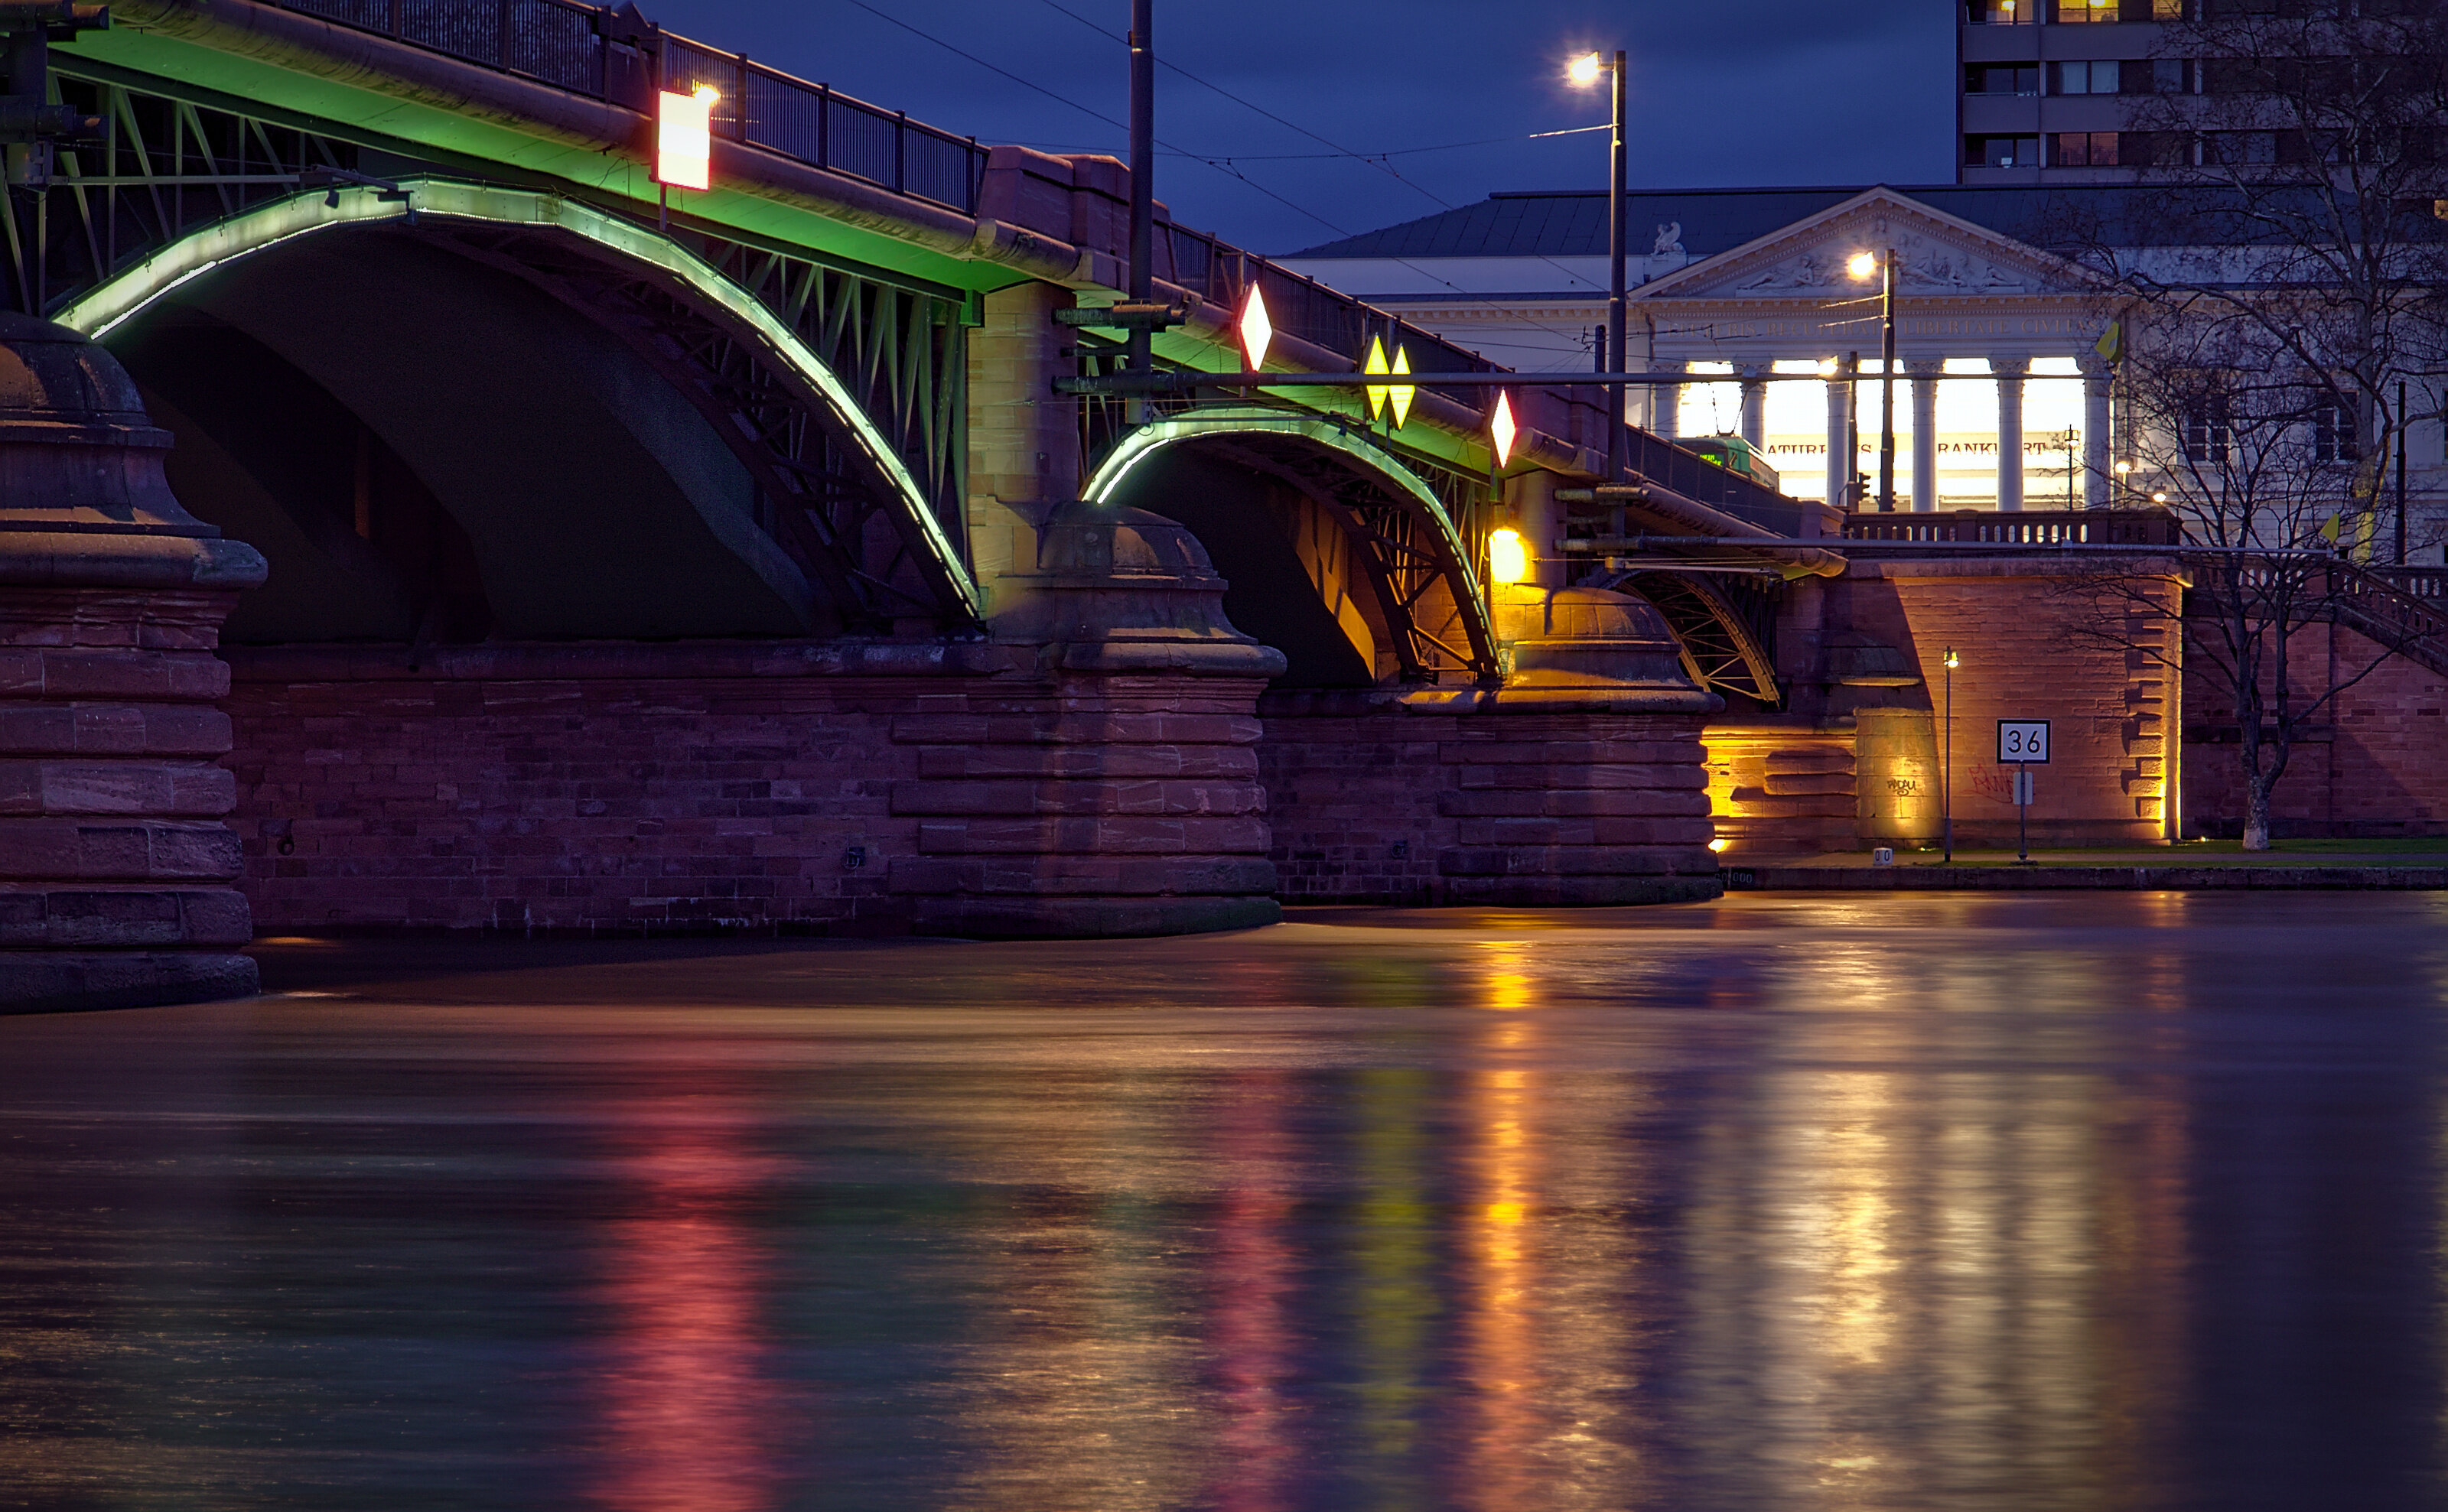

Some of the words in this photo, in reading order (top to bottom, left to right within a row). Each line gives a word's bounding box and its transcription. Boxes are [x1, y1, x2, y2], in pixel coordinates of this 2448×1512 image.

[1767, 320, 1884, 337] RECUPERAT
[1904, 320, 2011, 335] LIBERTATE
[2021, 319, 2098, 333] CIVITAS
[2007, 730, 2041, 753] 36
